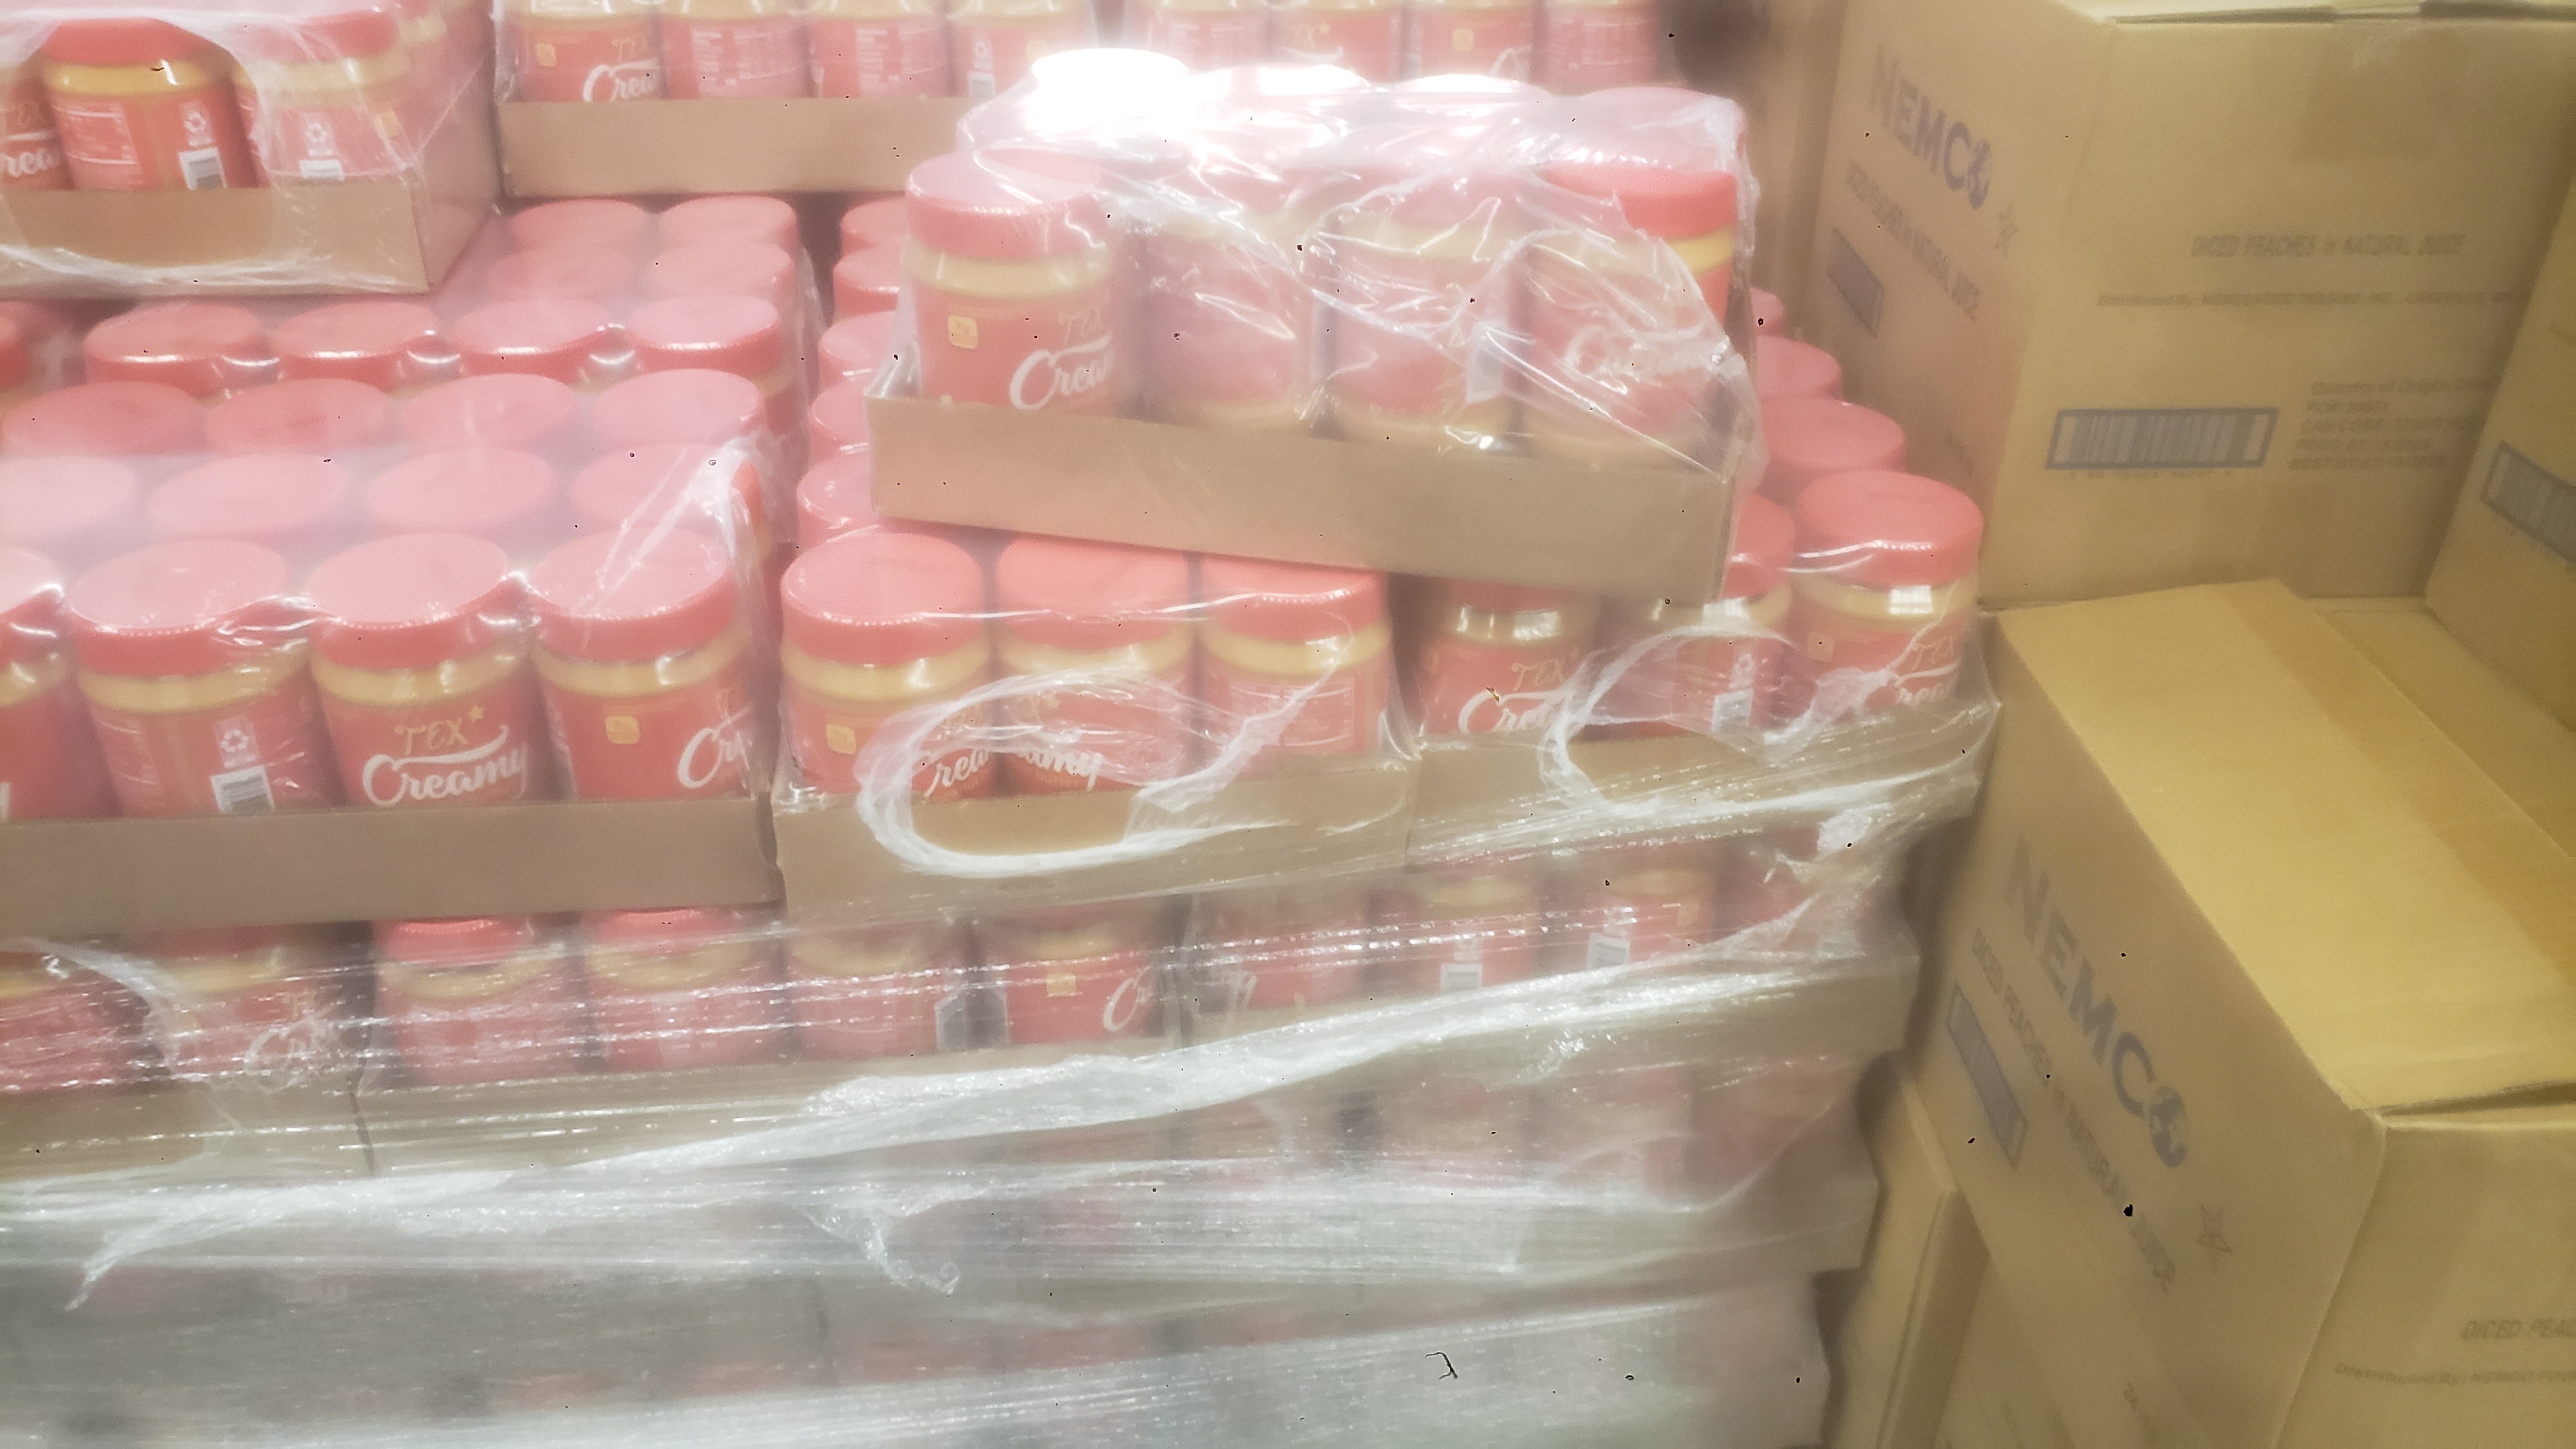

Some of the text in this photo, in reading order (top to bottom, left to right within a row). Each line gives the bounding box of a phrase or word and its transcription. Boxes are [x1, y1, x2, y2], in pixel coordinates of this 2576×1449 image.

[1868, 41, 1992, 210] NEMCO
[362, 724, 528, 805] Creamy
[394, 717, 470, 755] TEX
[2005, 833, 2189, 1167] NEMCO
